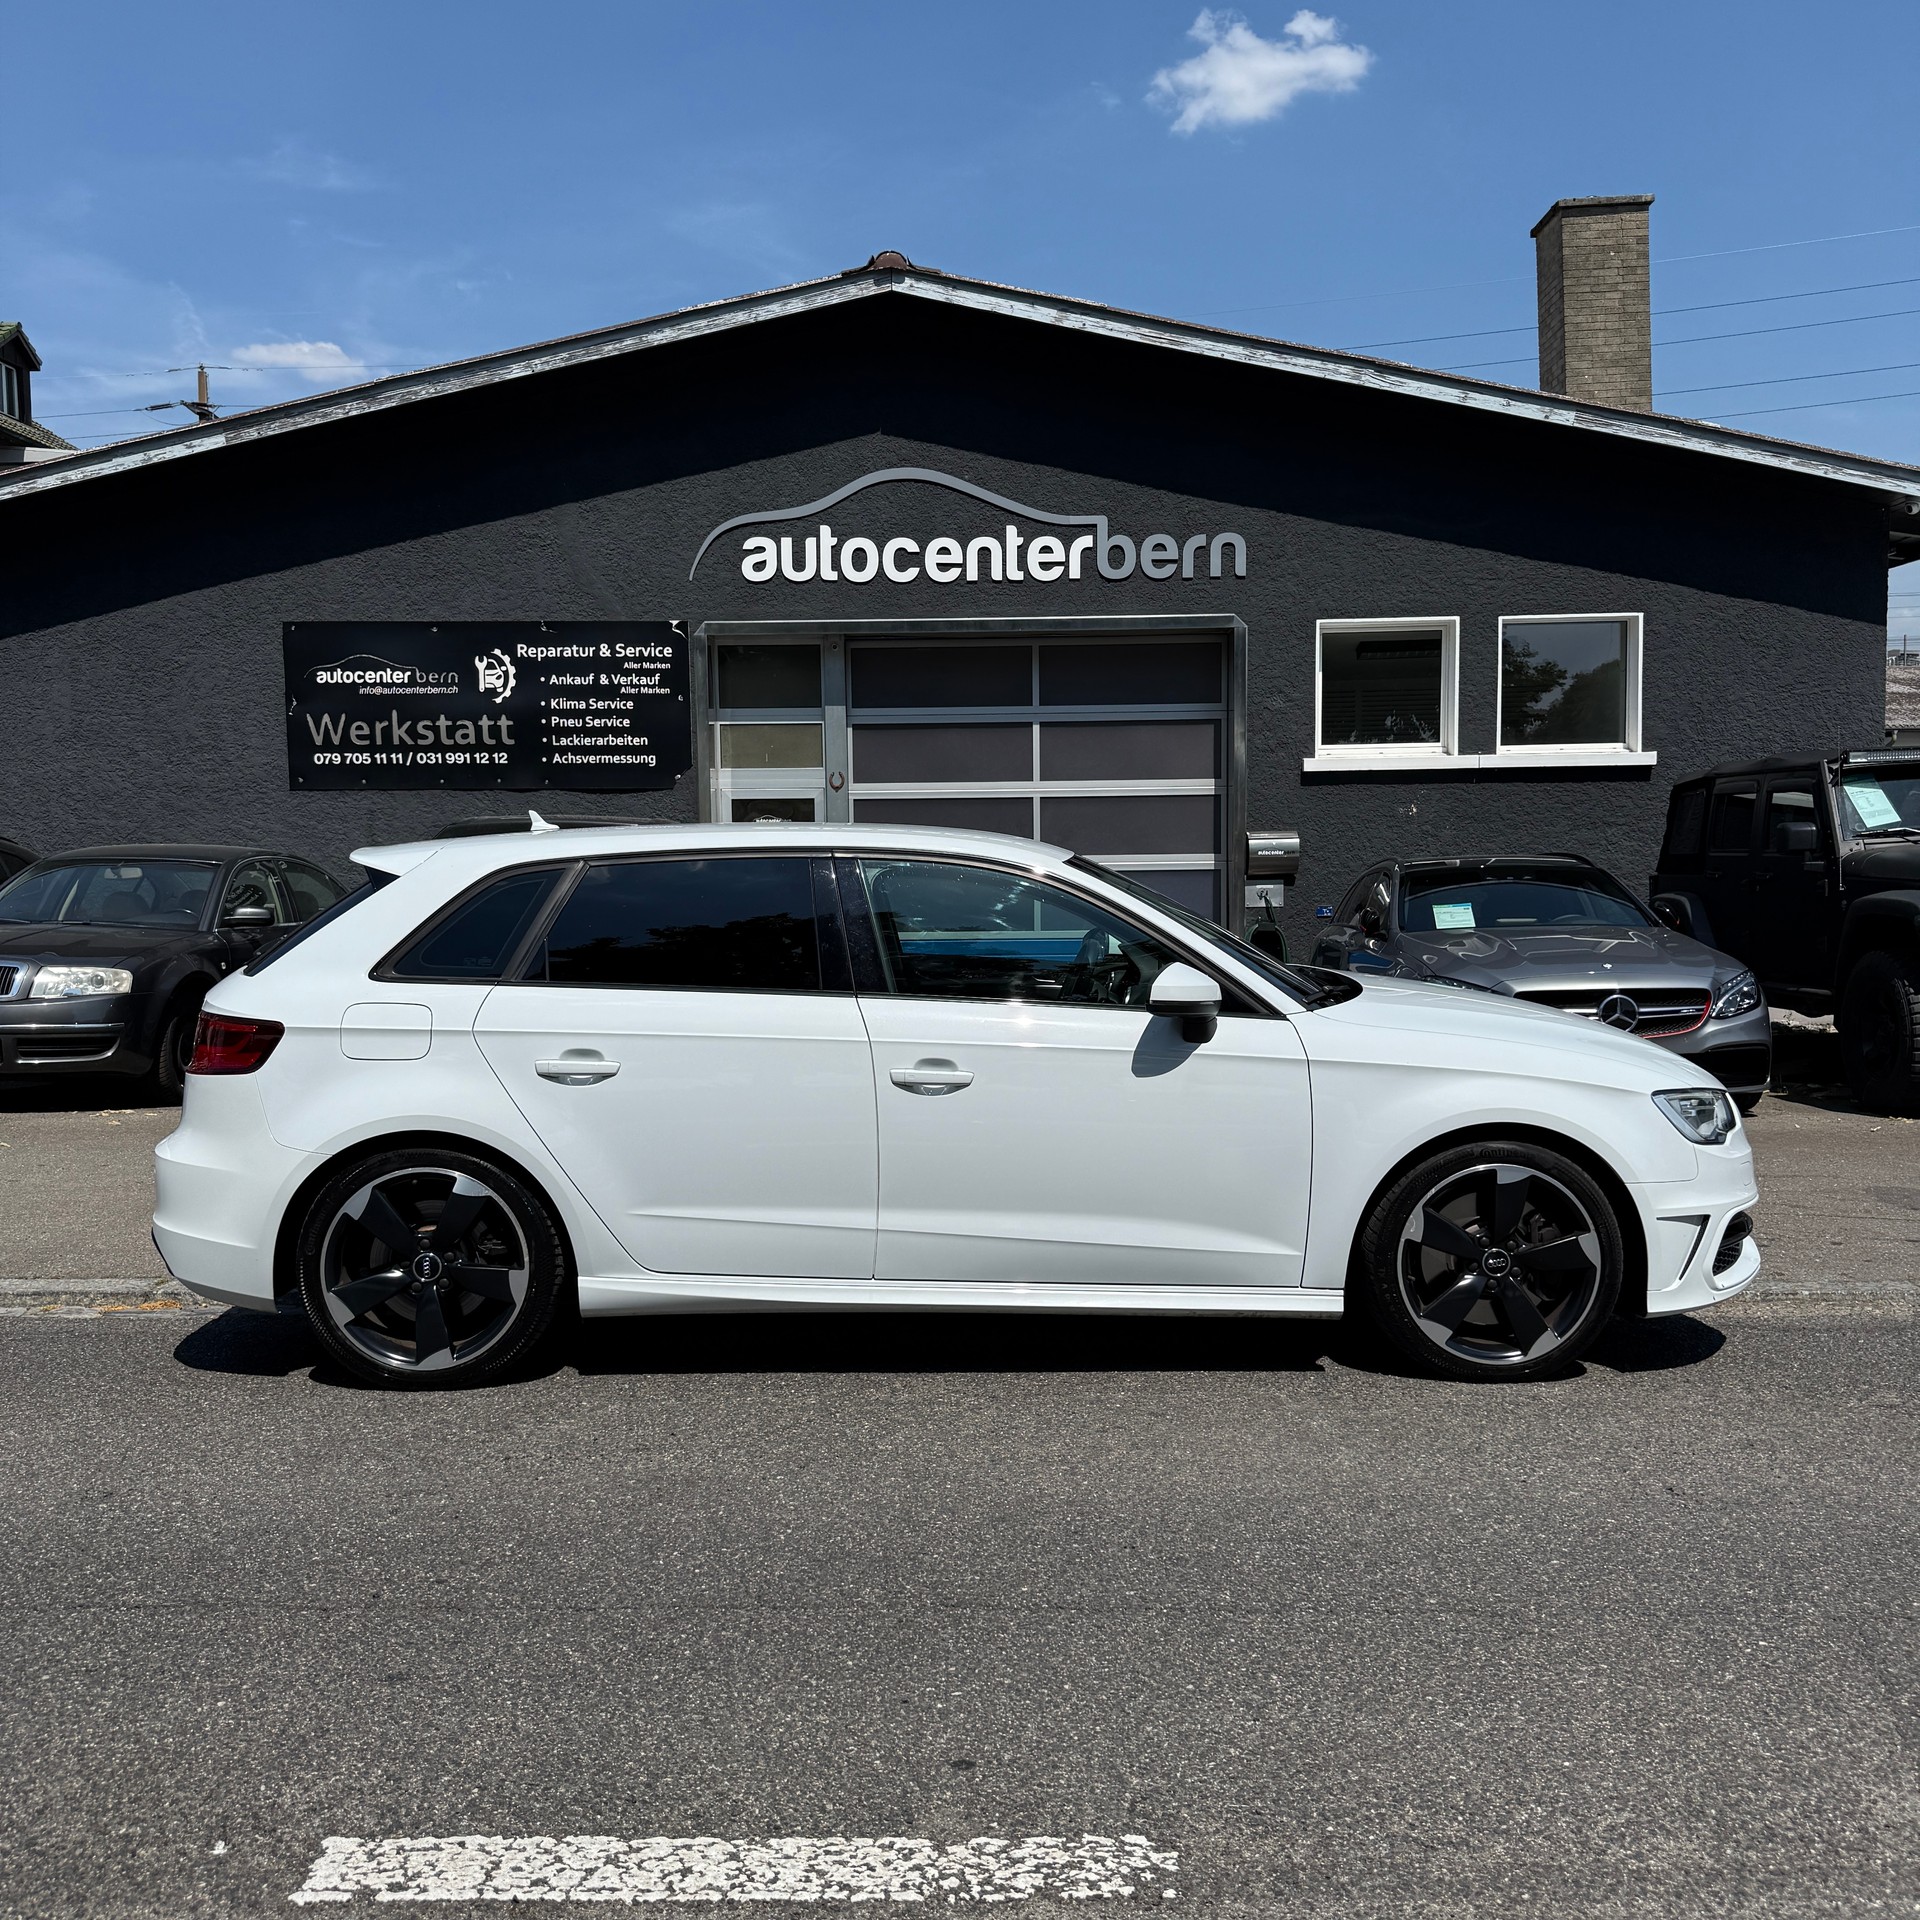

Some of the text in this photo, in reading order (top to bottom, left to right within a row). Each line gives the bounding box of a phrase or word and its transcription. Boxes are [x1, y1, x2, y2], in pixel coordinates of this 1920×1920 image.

[517, 643, 673, 661] Reparatur & Service
[623, 661, 671, 669] Aller Marken
[316, 667, 459, 684] autocenter bern
[549, 673, 661, 685] Ankauf & Verkauf
[359, 685, 459, 695] info@autocenterbern.ch
[620, 686, 671, 694] Aller Marken
[550, 697, 634, 710] Klima Service
[306, 709, 516, 746] Werkstatt
[551, 715, 631, 728] Pneu Service
[552, 734, 649, 746] Lackierarbeiten
[313, 753, 342, 765] 079
[344, 753, 372, 765] 705
[405, 751, 414, 766] /
[416, 753, 443, 764] 031
[445, 753, 471, 764] 991
[473, 752, 490, 764] 12
[491, 752, 509, 764] 12
[552, 752, 657, 767] Achsvermessung
